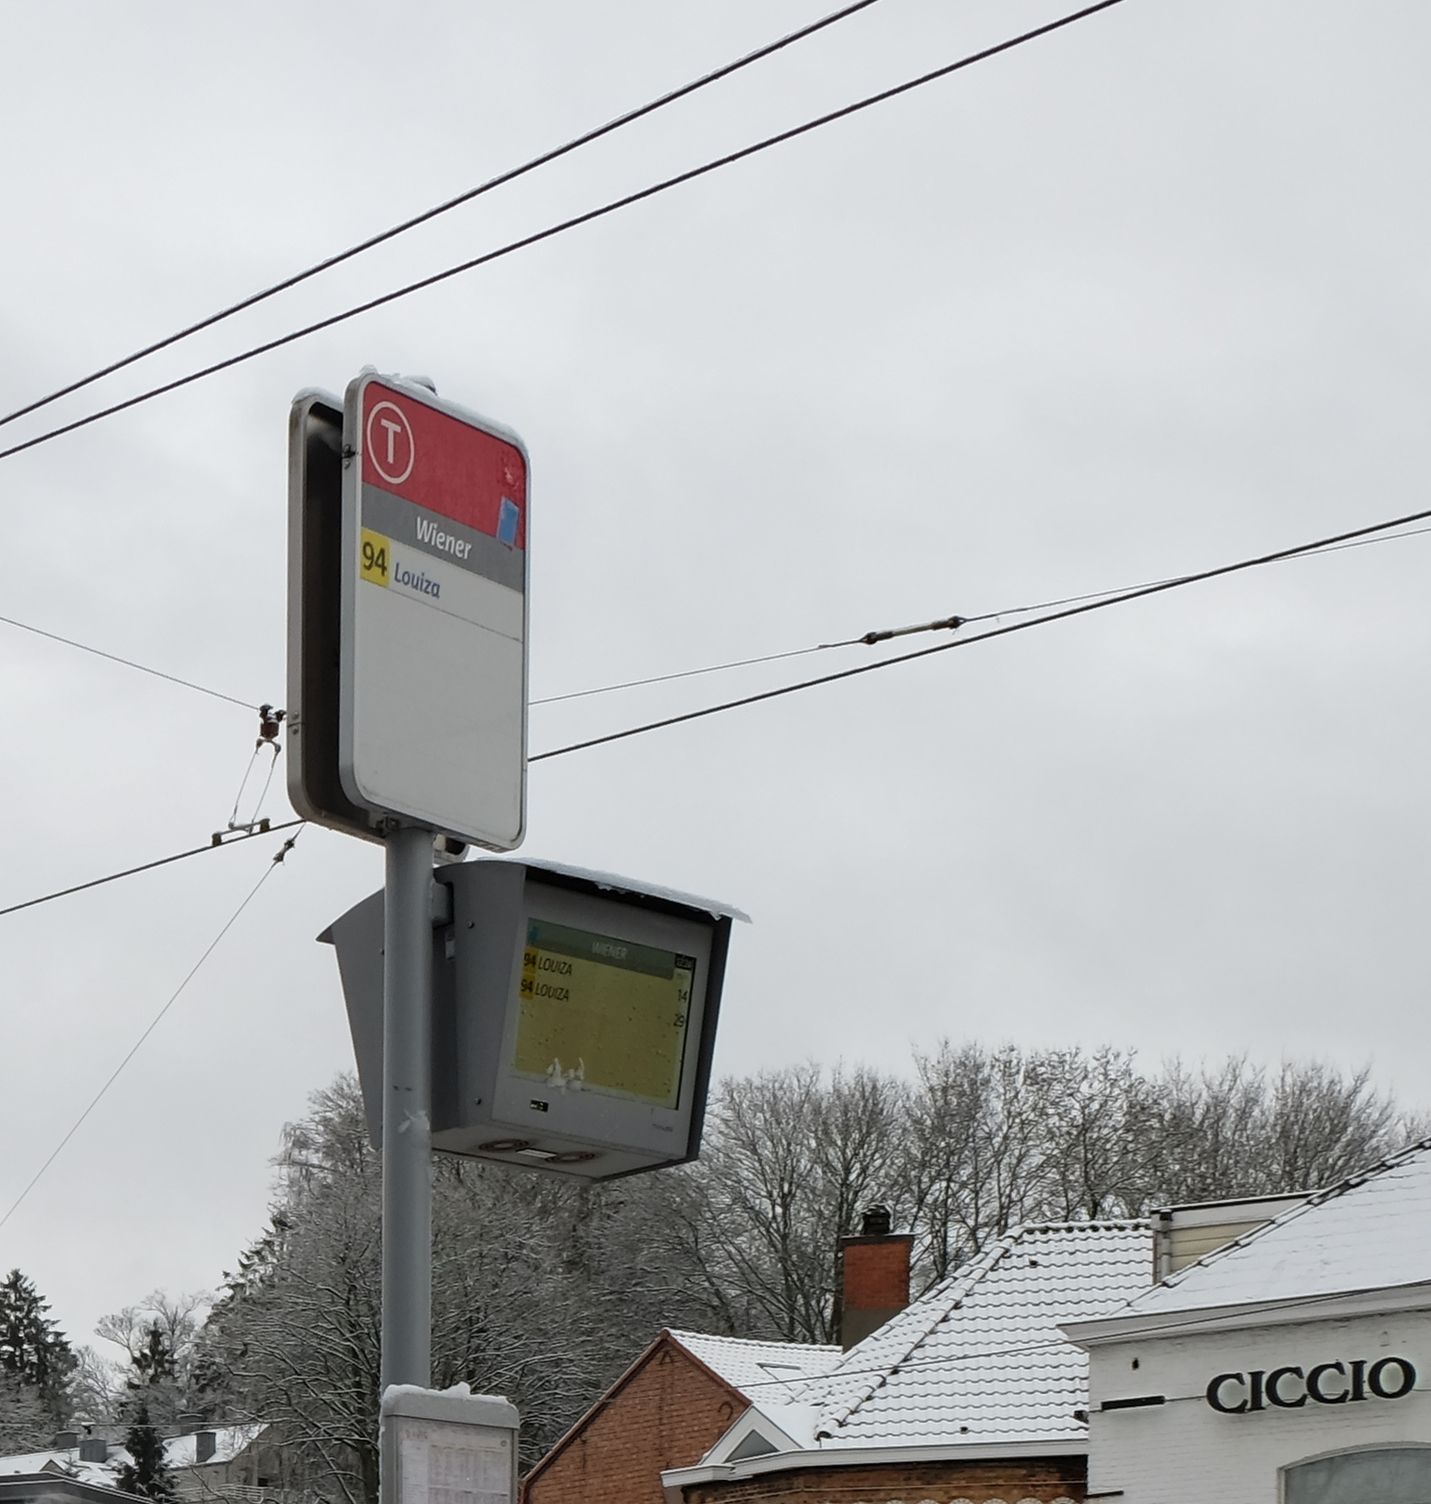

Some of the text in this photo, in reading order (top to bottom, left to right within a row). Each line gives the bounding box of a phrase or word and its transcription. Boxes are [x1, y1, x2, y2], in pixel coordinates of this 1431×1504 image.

[380, 418, 402, 464] T
[416, 515, 472, 560] Wiener
[362, 541, 441, 599] 94 Louiza
[523, 953, 572, 976] 94 LOUIZA
[521, 979, 570, 1001] 94 LOUIZA
[1206, 1356, 1416, 1414] CICCIO
